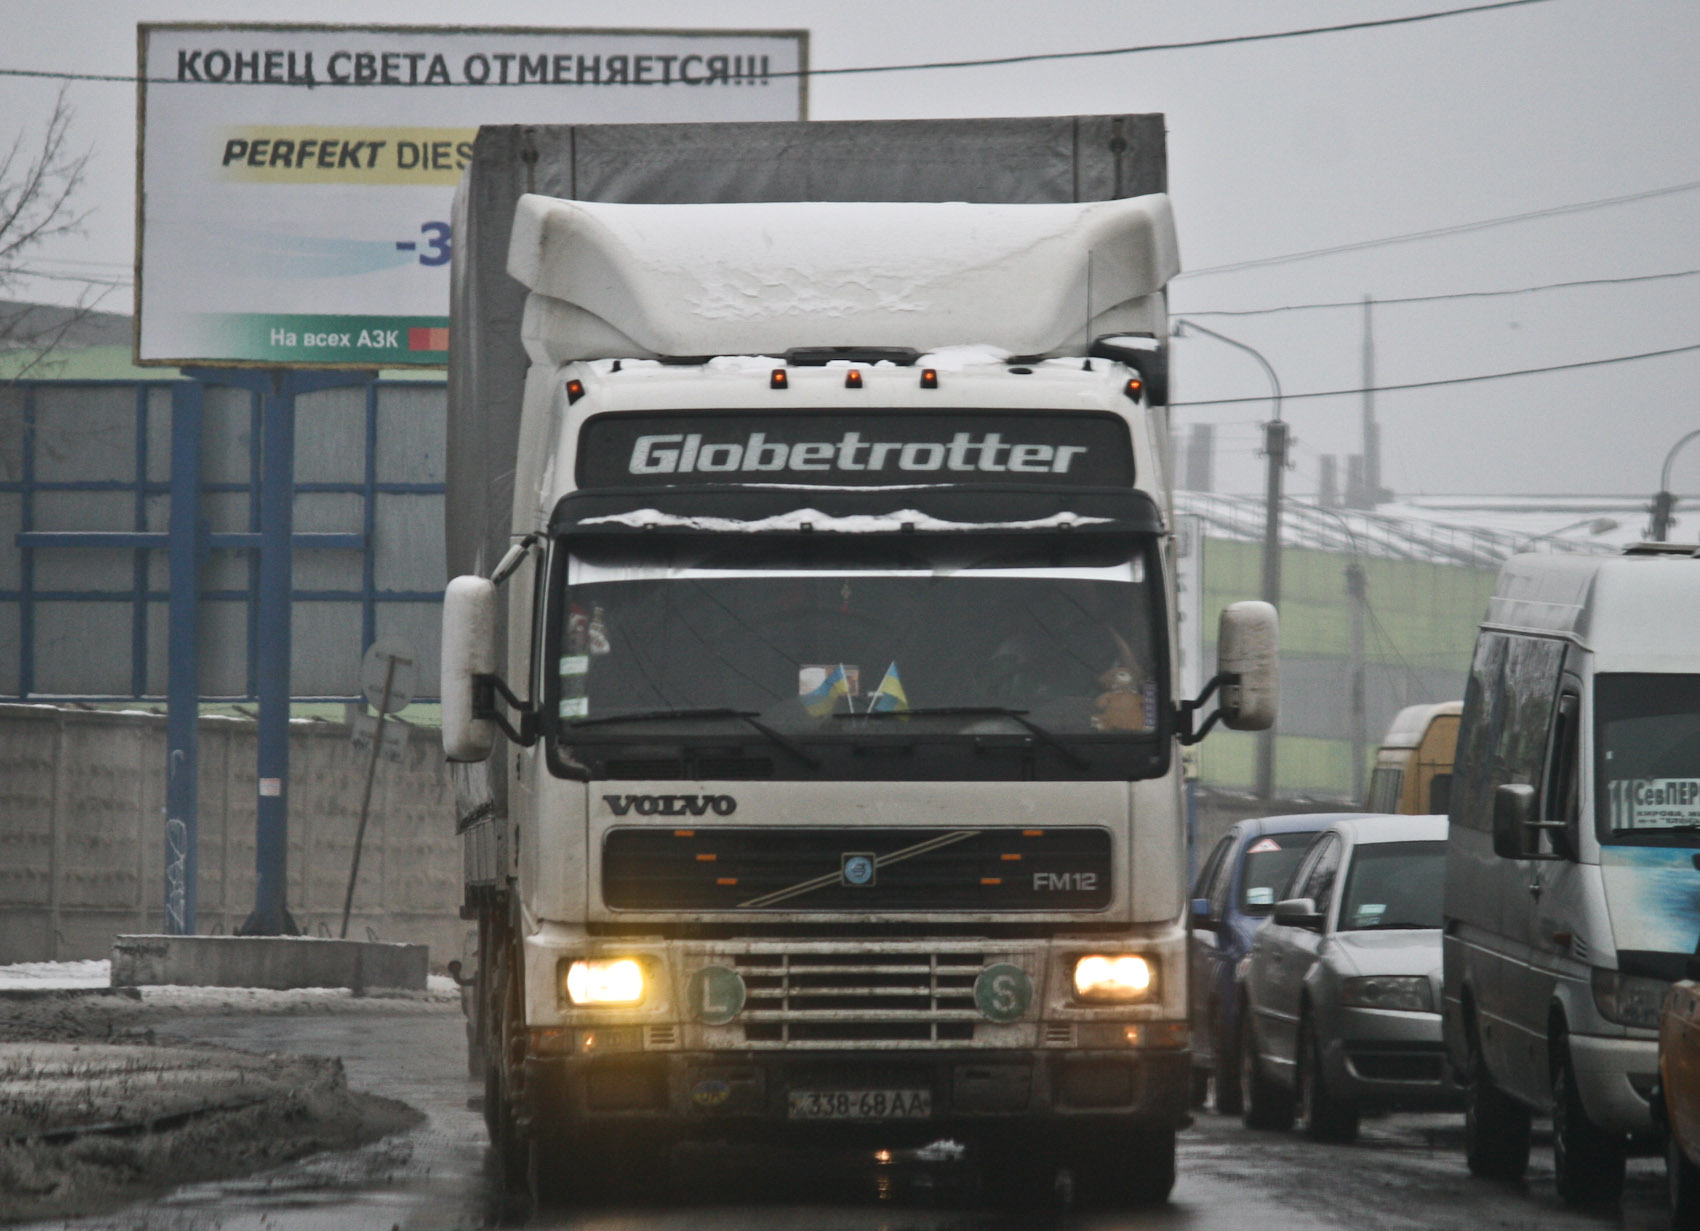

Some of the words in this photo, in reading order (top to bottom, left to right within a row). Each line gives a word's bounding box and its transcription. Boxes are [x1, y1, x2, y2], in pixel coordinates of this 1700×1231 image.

[177, 50, 315, 89] КОНЕЦ
[327, 51, 451, 85] СВЕТА
[463, 53, 769, 85] ОТМЕНЯЕТСЯ!!!
[222, 139, 386, 169] PERFEKT
[270, 328, 297, 347] На
[304, 332, 351, 347] всех
[628, 431, 1087, 475] Globetrotter
[602, 794, 737, 816] VOLVO
[1033, 872, 1097, 891] FM12
[703, 974, 728, 1013] L
[992, 974, 1016, 1012] S
